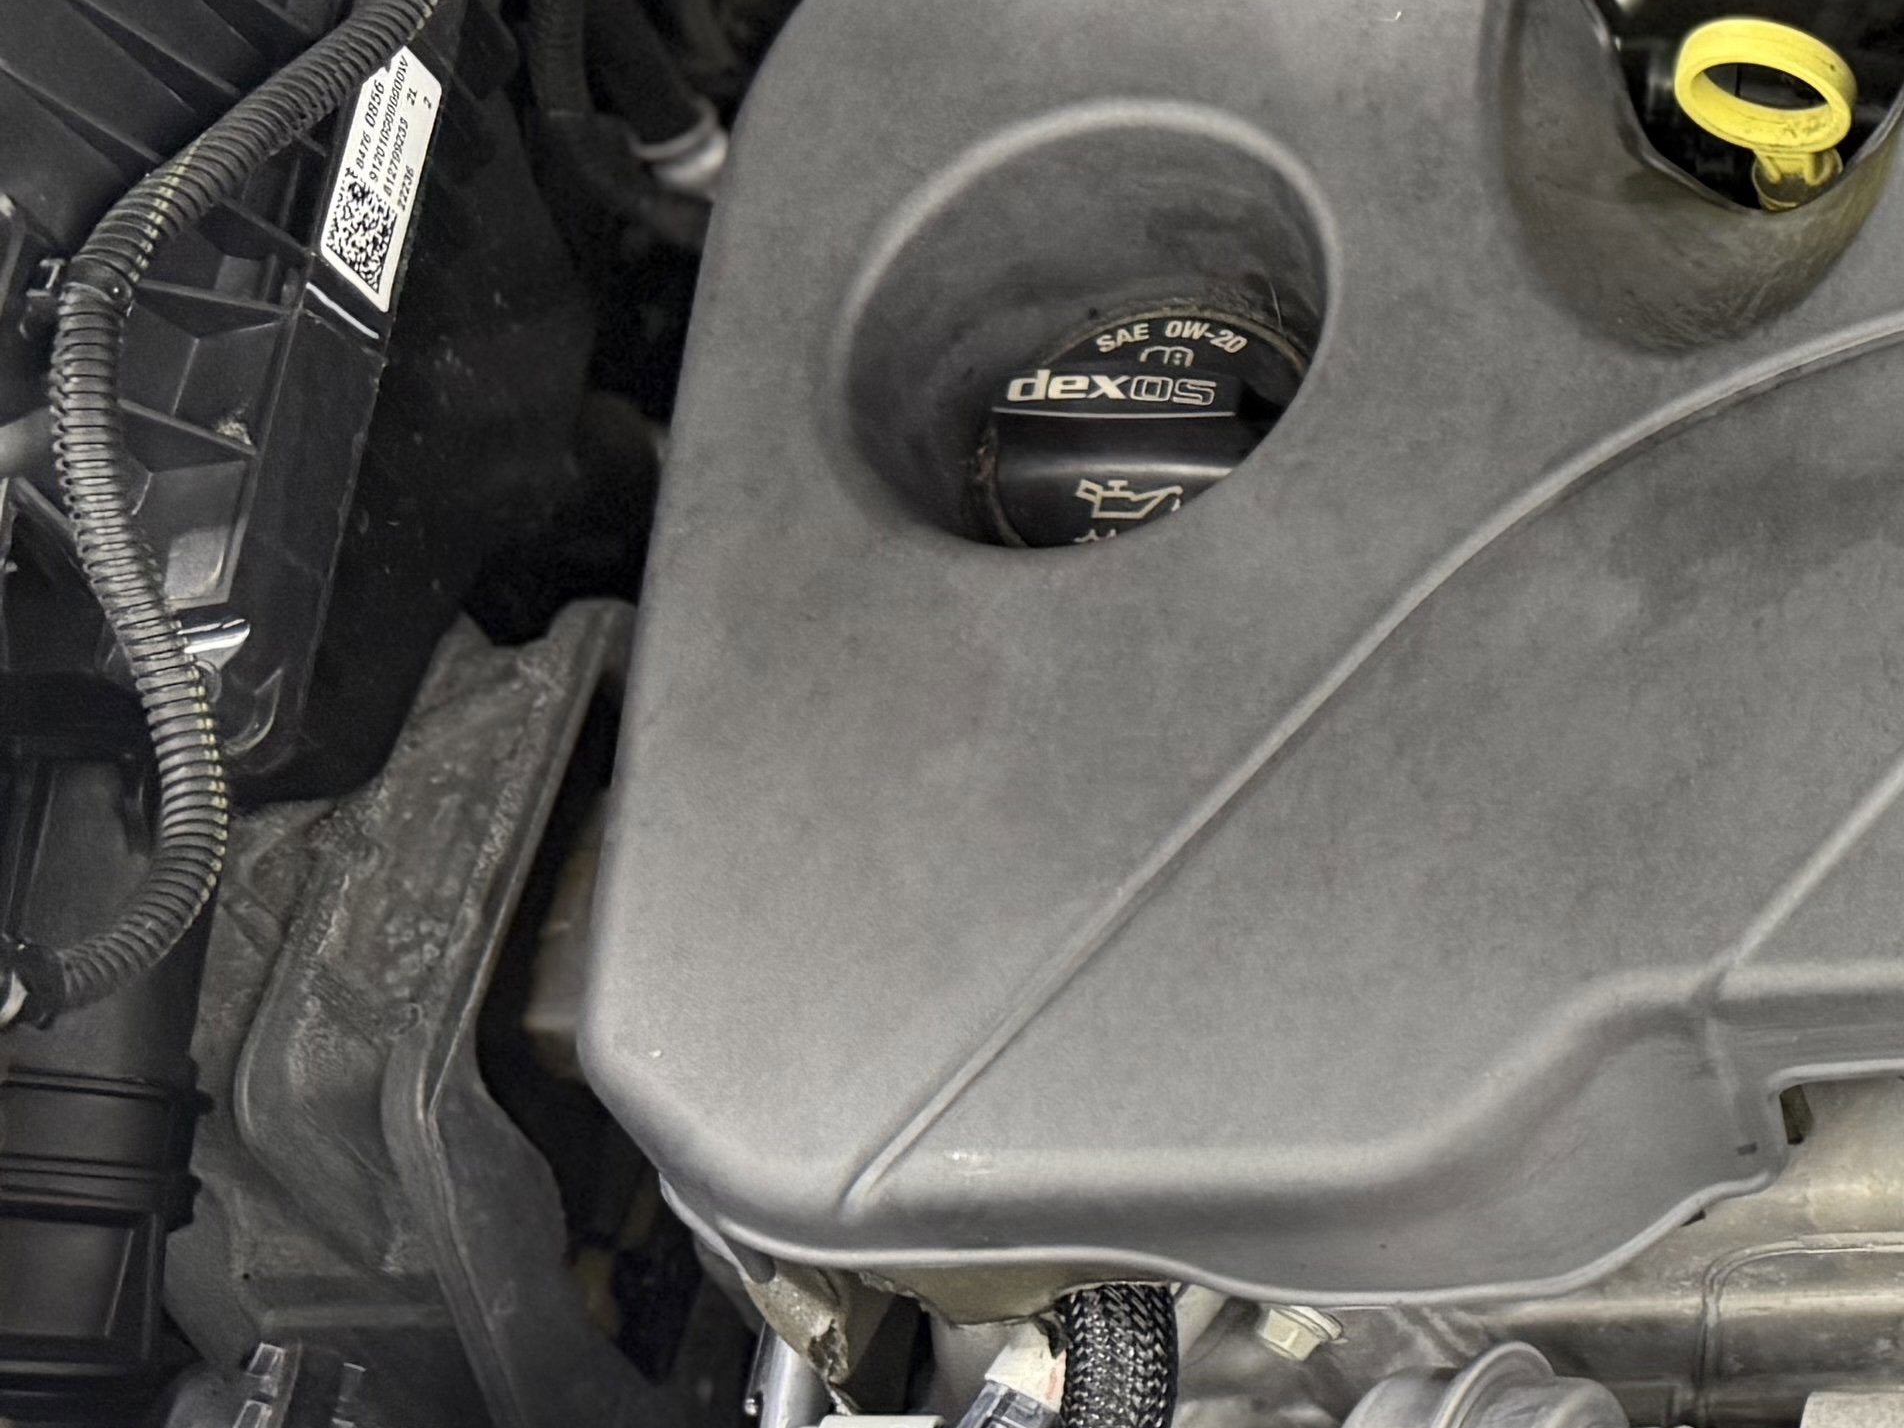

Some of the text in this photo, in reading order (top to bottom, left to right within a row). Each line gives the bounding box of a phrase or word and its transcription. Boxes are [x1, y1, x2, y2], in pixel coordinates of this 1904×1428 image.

[363, 79, 386, 129] 0856
[1096, 320, 1248, 354] SAE 0W-20
[1006, 368, 1217, 406] dexos
